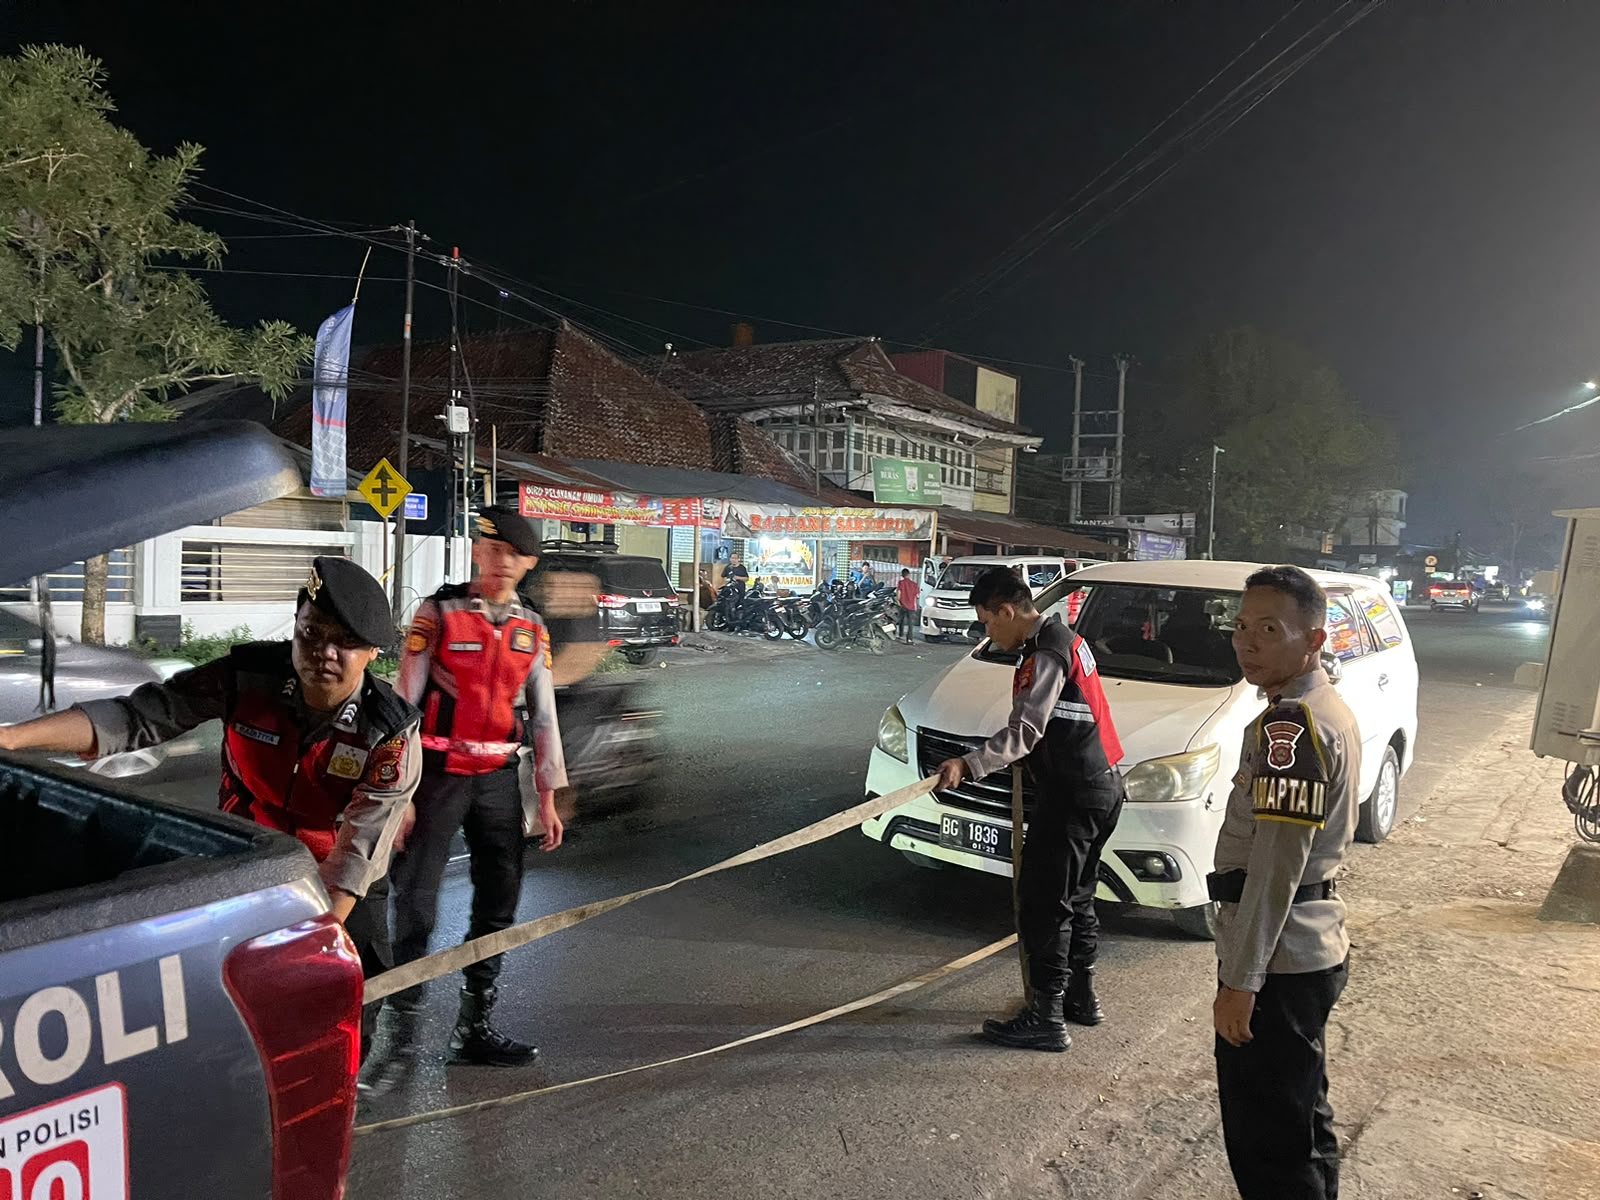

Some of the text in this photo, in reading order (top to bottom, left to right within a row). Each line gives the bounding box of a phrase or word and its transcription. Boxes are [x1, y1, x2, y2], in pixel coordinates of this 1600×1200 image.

[942, 816, 959, 837] BG
[968, 822, 999, 846] 1836
[16, 1105, 100, 1152] POLISI
